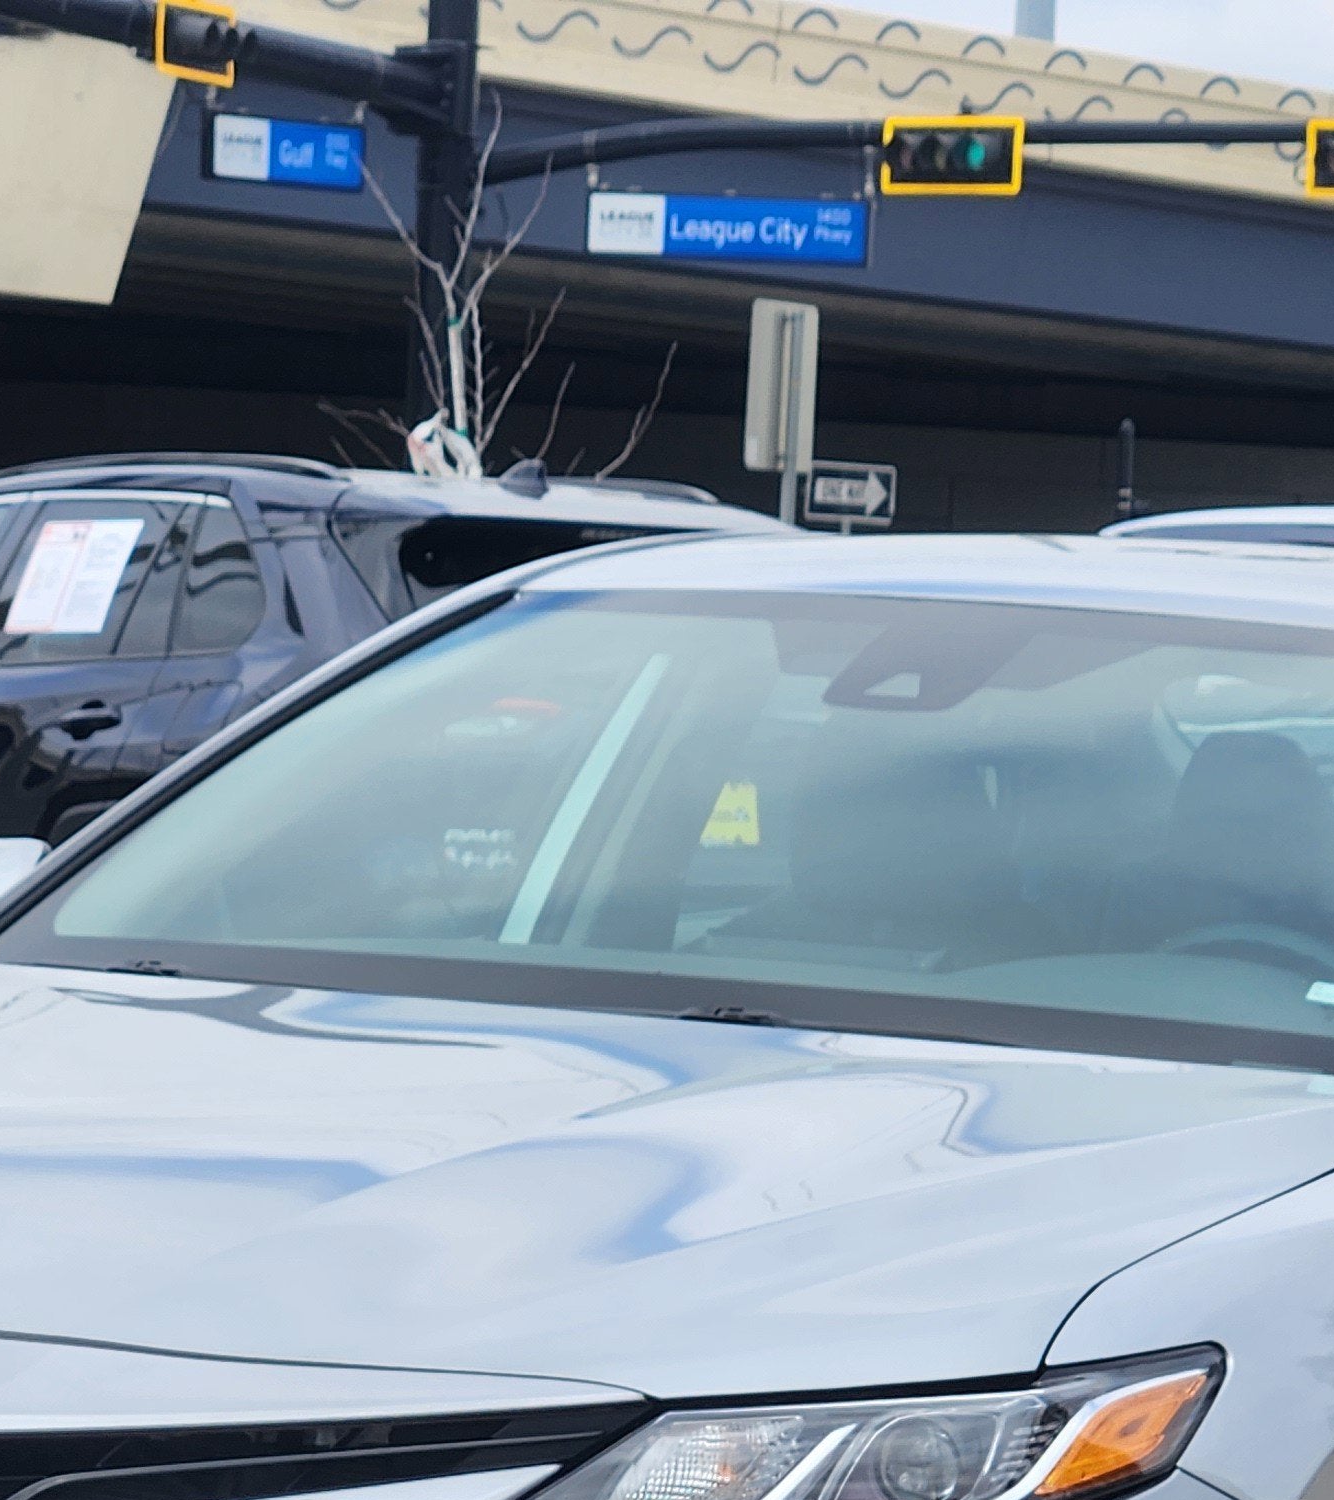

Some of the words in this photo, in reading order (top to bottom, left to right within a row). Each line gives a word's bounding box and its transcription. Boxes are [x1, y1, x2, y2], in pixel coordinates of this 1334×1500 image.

[278, 138, 316, 169] Gulf
[669, 213, 755, 250] League
[758, 216, 809, 250] City
